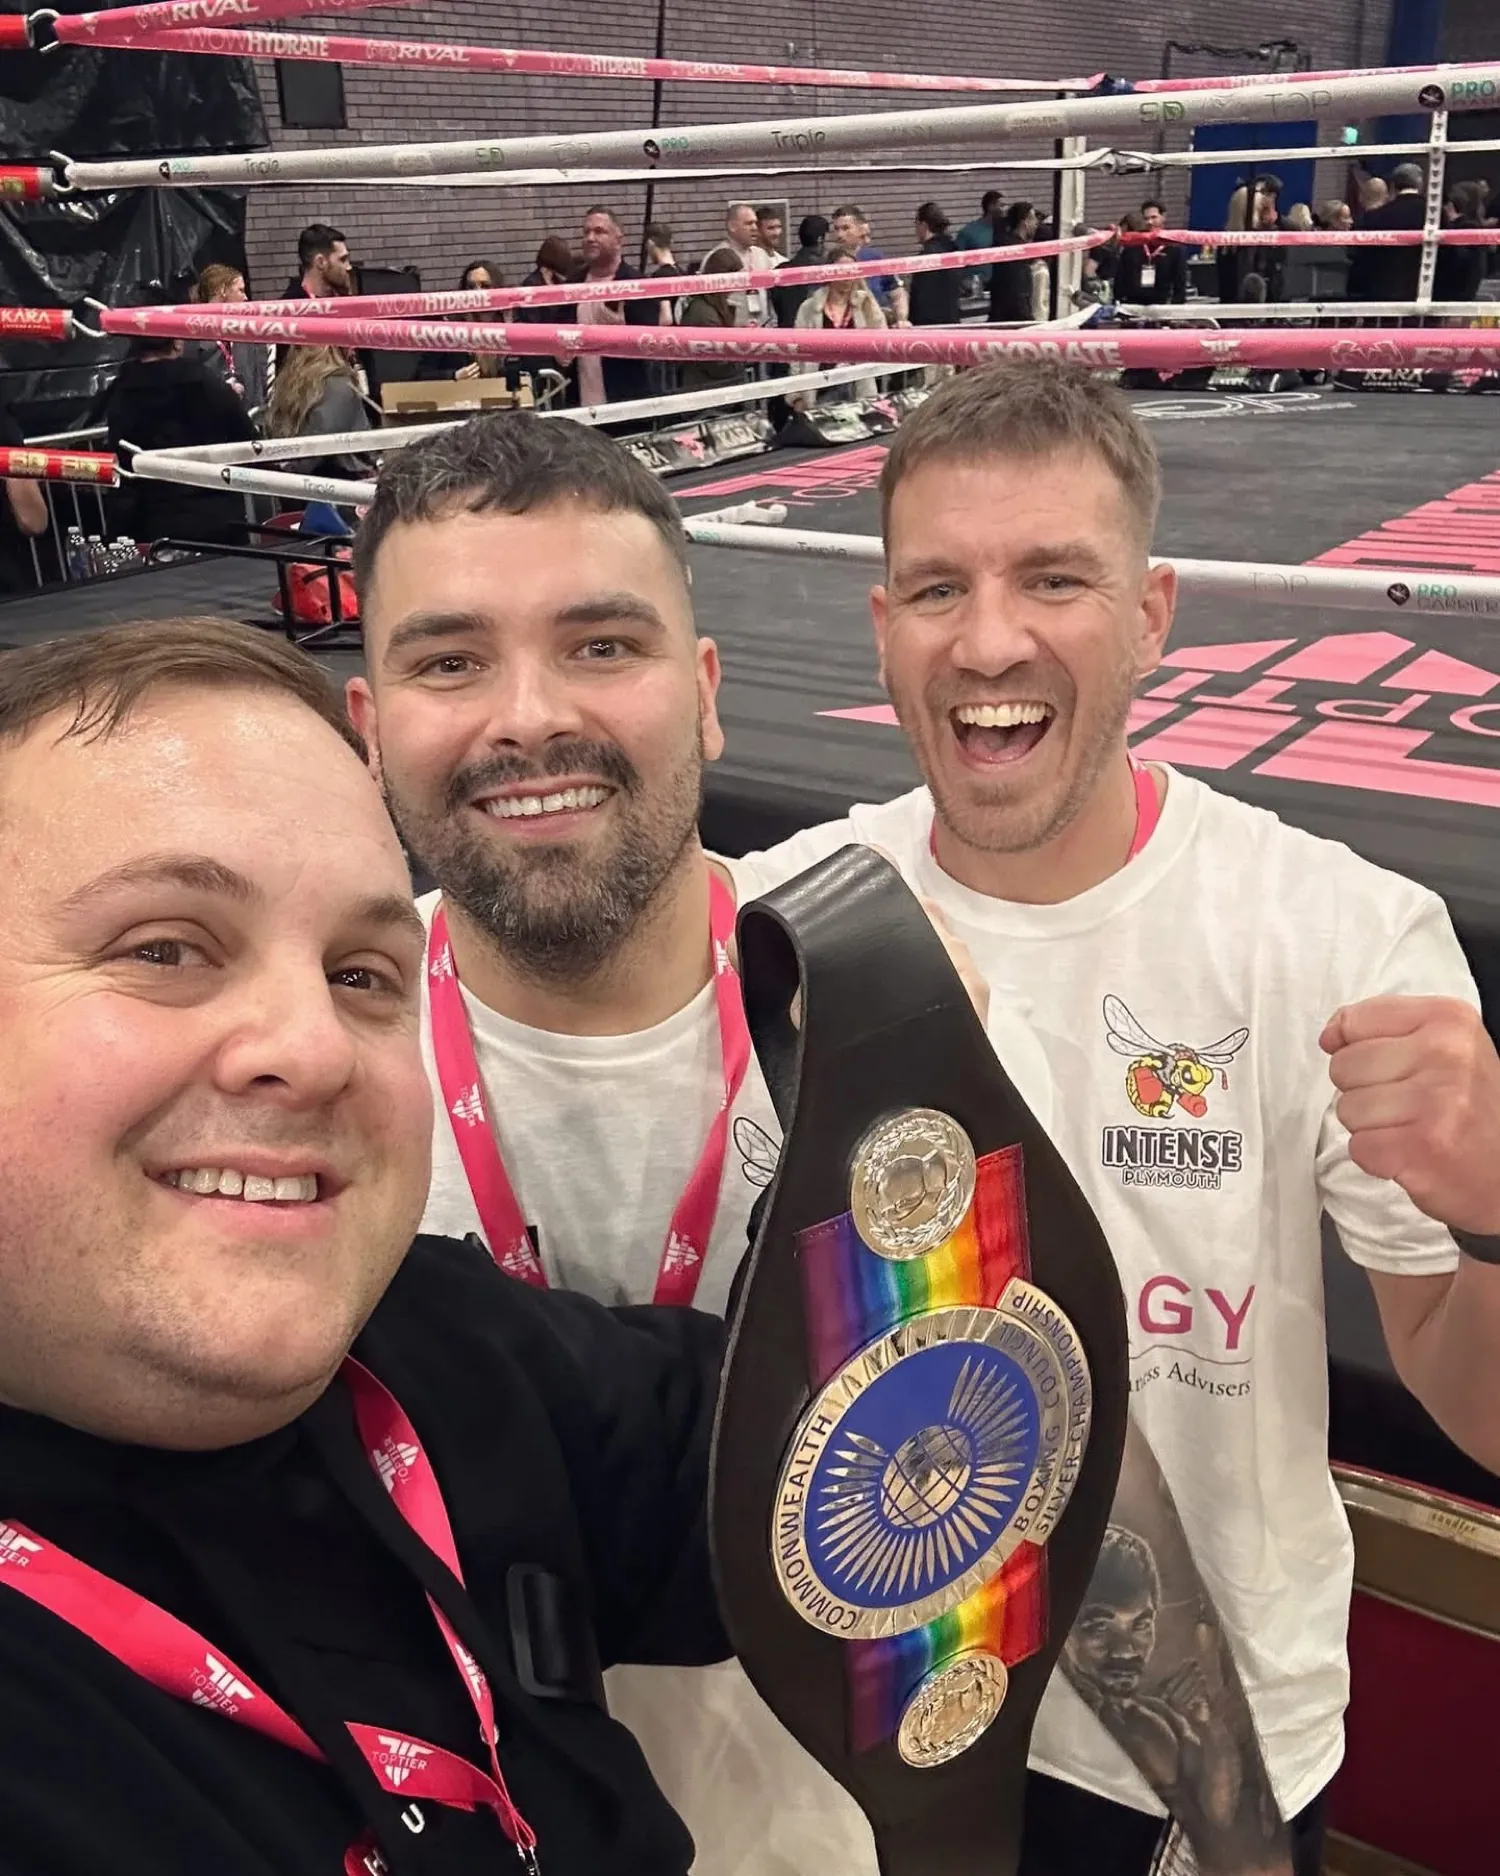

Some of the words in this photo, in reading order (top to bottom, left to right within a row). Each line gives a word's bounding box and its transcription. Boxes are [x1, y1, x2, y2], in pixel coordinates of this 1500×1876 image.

[172, 0, 259, 21] RIVAL
[399, 45, 470, 62] RIVAL
[771, 129, 826, 151] Triple
[1452, 80, 1496, 98] PRO
[1, 309, 51, 323] KARA
[259, 301, 338, 316] RIVAL
[221, 318, 306, 339] RIVAL
[688, 340, 812, 357] RIVAL
[1417, 584, 1457, 597] PRO
[1105, 1128, 1242, 1171] INTENSE
[1123, 1169, 1221, 1189] PLYMOUTH
[1138, 1275, 1256, 1350] GY
[1012, 1291, 1087, 1442] CHAMPIONSHIP
[1167, 1361, 1251, 1397] Advisers
[1014, 1425, 1061, 1533] BOXING
[1035, 1454, 1081, 1535] SILVER
[780, 1414, 858, 1631] COMMONWEALTH
[189, 1667, 239, 1715] TOPTIER
[371, 1750, 427, 1771] TOPTIER
